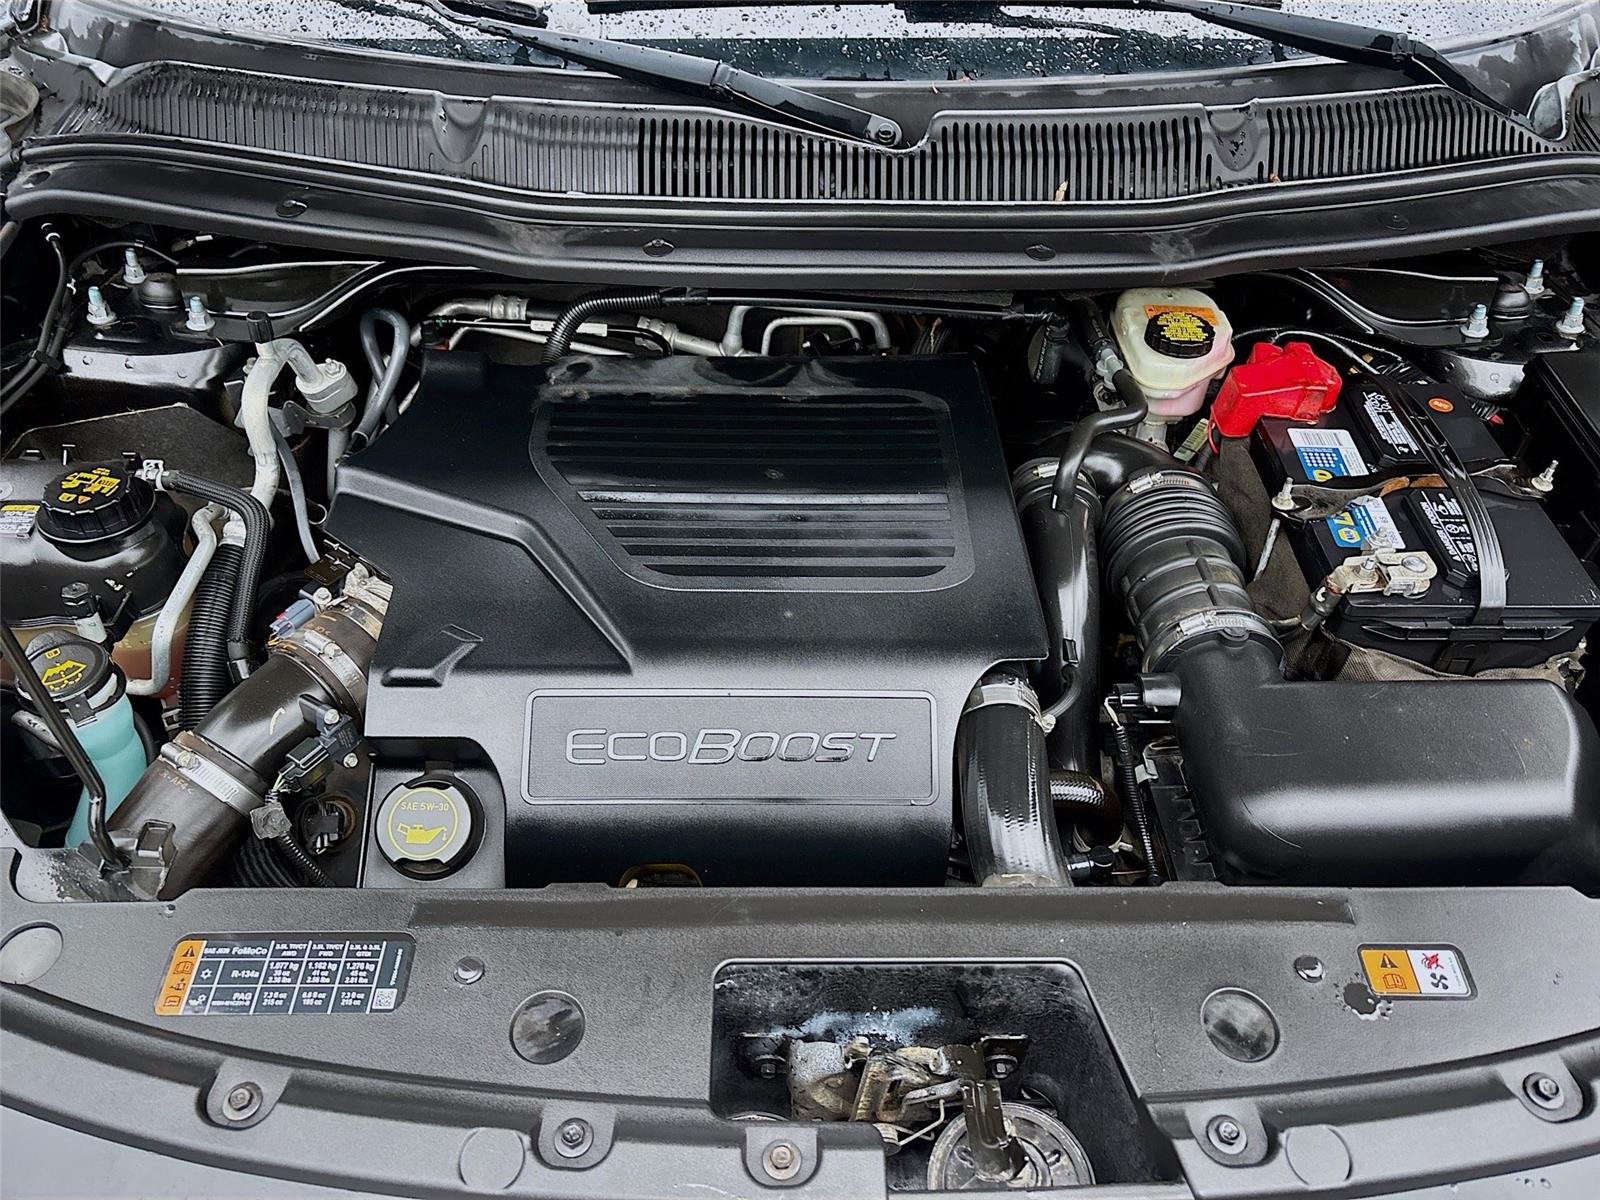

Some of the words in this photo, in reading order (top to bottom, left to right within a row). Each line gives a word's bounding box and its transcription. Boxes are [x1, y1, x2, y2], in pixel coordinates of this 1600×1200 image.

[400, 801, 417, 811] SAE
[420, 802, 450, 811] 5W-30
[232, 947, 267, 955] FoMoCo
[289, 961, 300, 971] kg
[327, 962, 338, 971] kg
[365, 962, 375, 972] kg
[231, 970, 259, 978] R-134a
